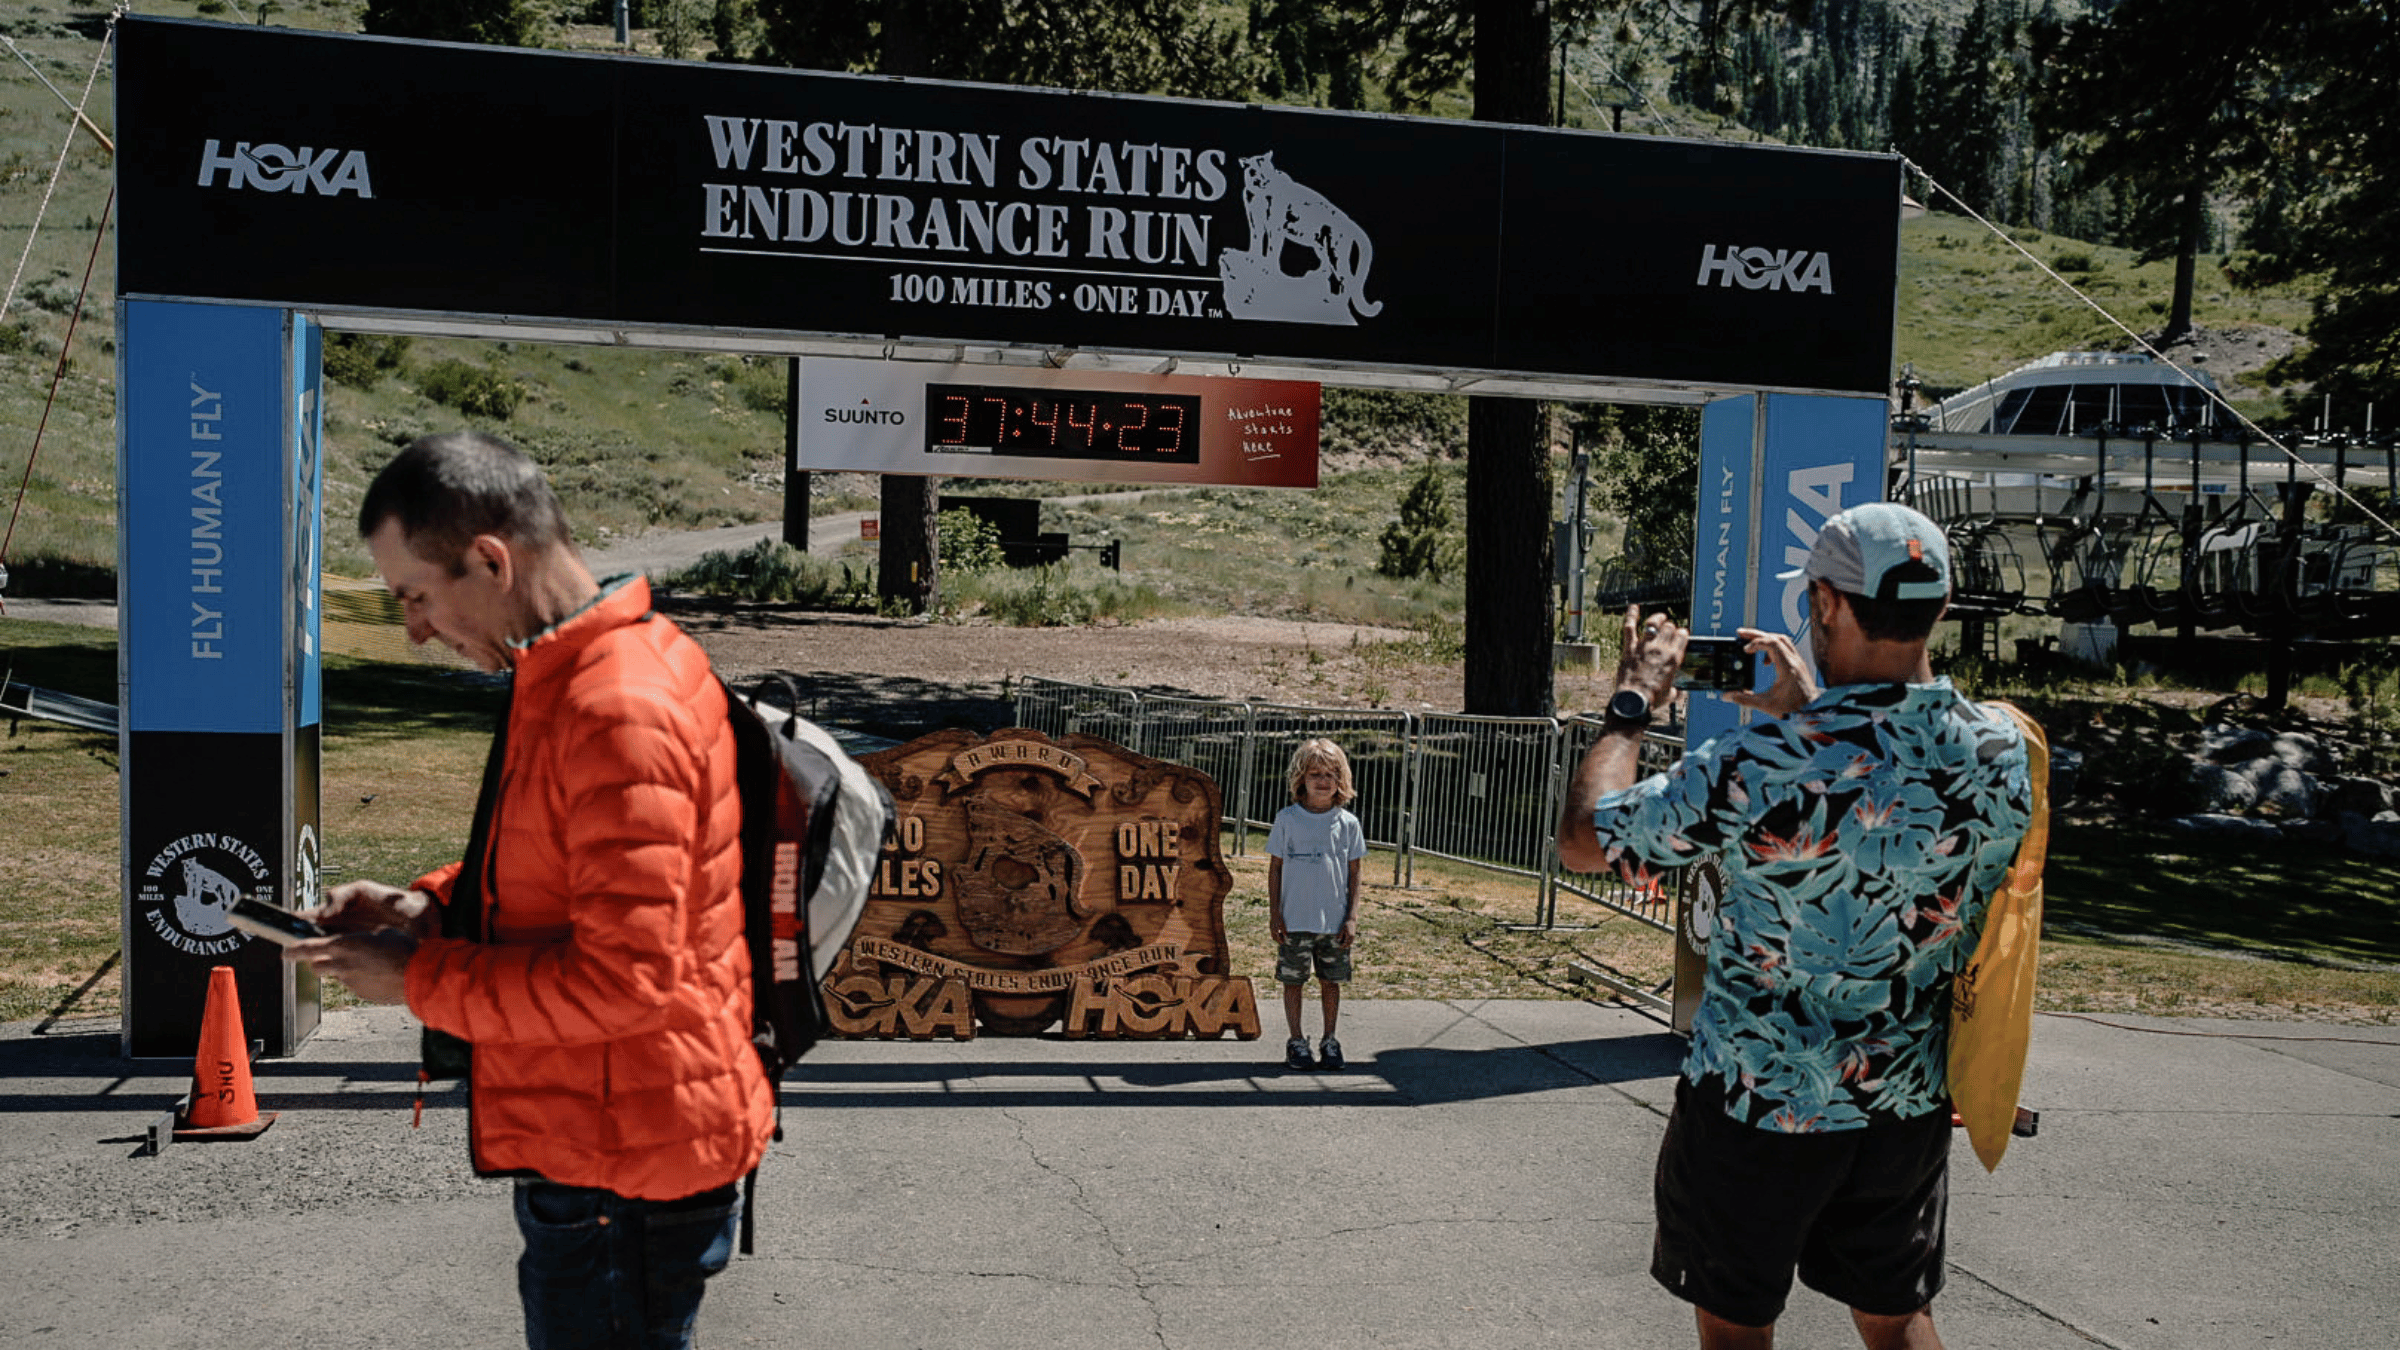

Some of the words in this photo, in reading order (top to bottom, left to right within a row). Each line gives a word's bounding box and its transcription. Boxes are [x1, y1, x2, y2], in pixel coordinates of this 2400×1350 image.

[197, 139, 372, 198] HOKA
[703, 115, 1000, 187] WESTERN
[1018, 136, 1227, 201] STATES
[701, 183, 1069, 257] ENDURANCE
[1085, 206, 1212, 266] RUN
[1697, 244, 1832, 294] HOKA
[889, 273, 945, 303] 100
[950, 277, 1052, 309] MILES
[1073, 283, 1138, 314] ONE
[1146, 287, 1208, 318] DAY
[191, 382, 222, 440] FLY
[824, 408, 905, 426] SUUNTO
[1228, 403, 1293, 420] Adventure
[1720, 465, 1734, 514] FLY
[191, 451, 223, 593] HUMAN
[191, 601, 223, 659] FLY
[966, 744, 1072, 769] AWARD
[146, 833, 217, 878] WESTERN
[219, 835, 270, 880] STATES
[1118, 822, 1179, 858] ONE
[138, 893, 165, 901] MILES
[143, 884, 158, 893] 100
[255, 885, 274, 893] ONE
[871, 859, 941, 897] LES
[1120, 864, 1180, 900] DAY
[146, 908, 240, 956] ENDURANCE
[860, 941, 945, 978] WESTERN
[1027, 956, 1134, 989] ENDUANCE
[1138, 946, 1176, 964] RUN
[820, 976, 971, 1034] OKA
[1068, 973, 1258, 1034] HOKA
